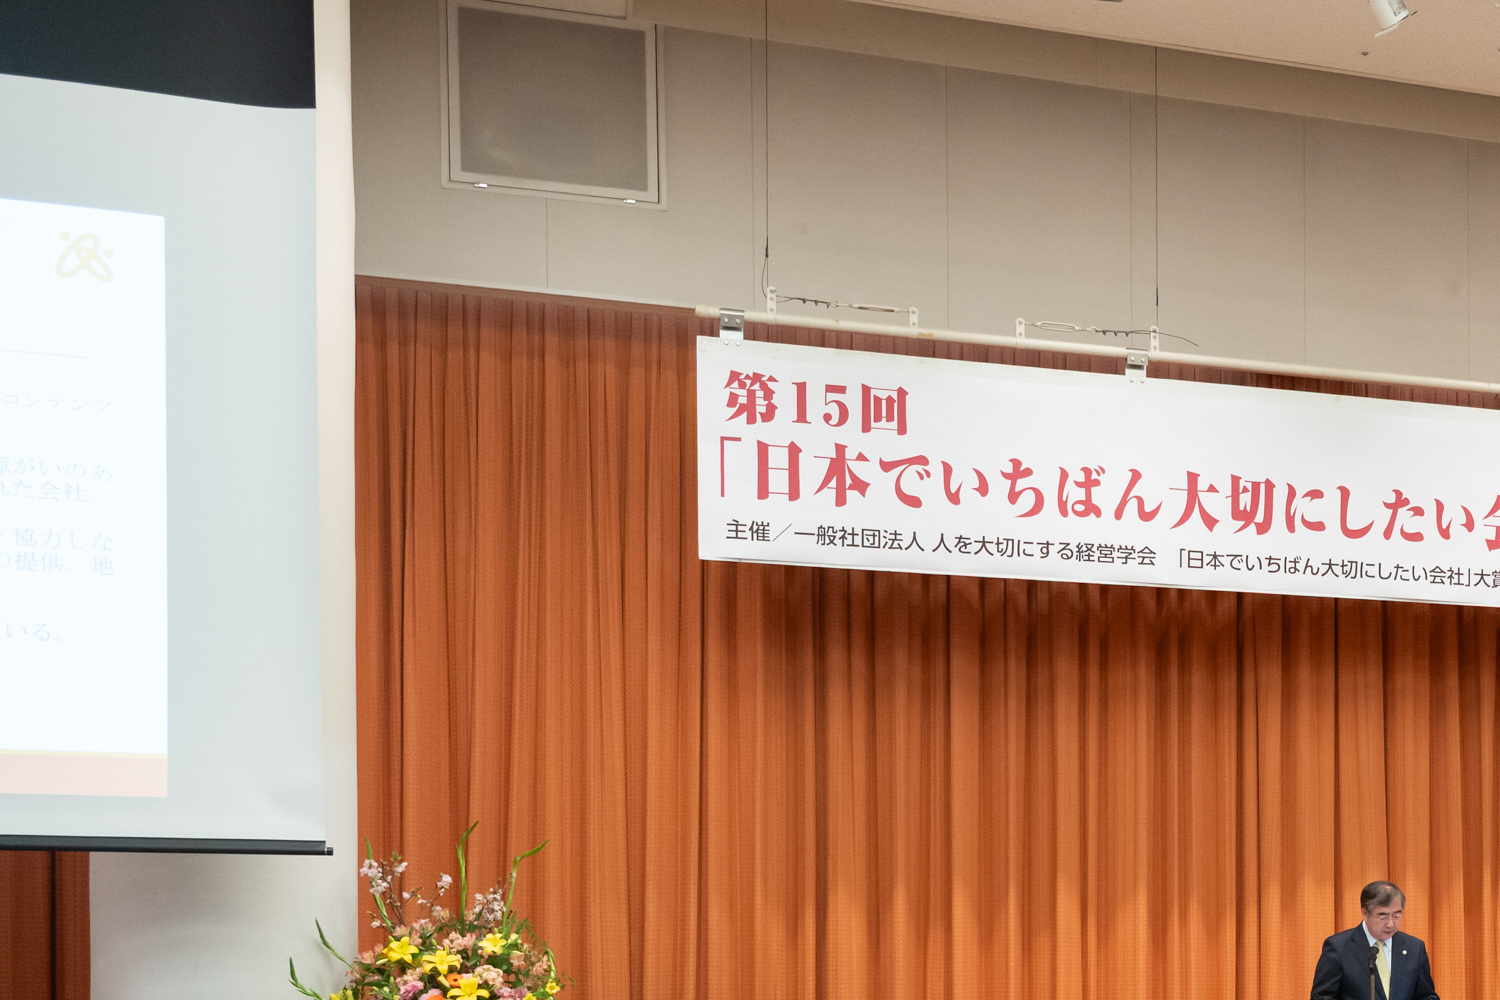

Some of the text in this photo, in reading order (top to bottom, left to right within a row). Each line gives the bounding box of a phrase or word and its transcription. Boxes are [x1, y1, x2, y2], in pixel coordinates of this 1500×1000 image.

[723, 369, 909, 436] 第15回
[725, 518, 925, 553] 主催／一般社団法人
[932, 531, 1157, 568] 人を大切にする経営学会
